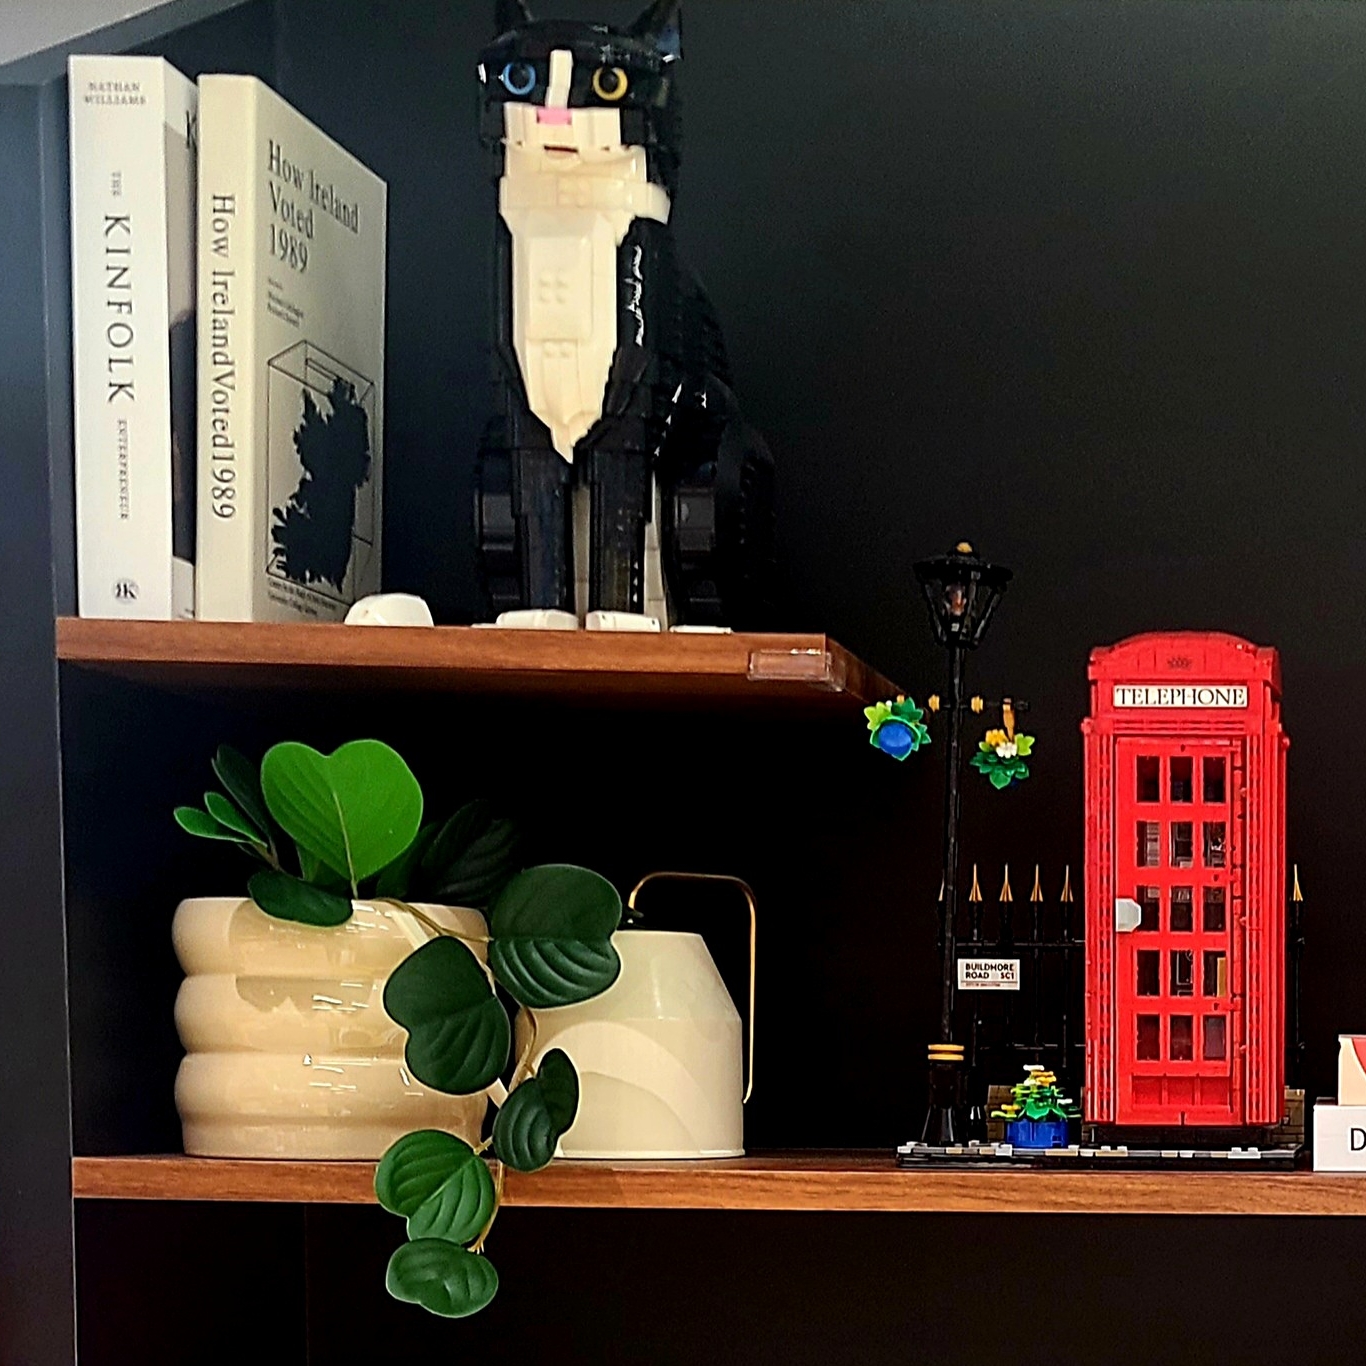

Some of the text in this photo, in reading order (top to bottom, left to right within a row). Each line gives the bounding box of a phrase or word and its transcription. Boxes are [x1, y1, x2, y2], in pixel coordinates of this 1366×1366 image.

[89, 82, 140, 91] NATHAN
[268, 140, 359, 234] How Ireland
[269, 180, 314, 239] Voted
[270, 224, 308, 273] 1989
[104, 213, 136, 403] KINFOLK
[211, 194, 236, 519] How IrelandVoted1989
[1117, 688, 1244, 705] TELEPHONE
